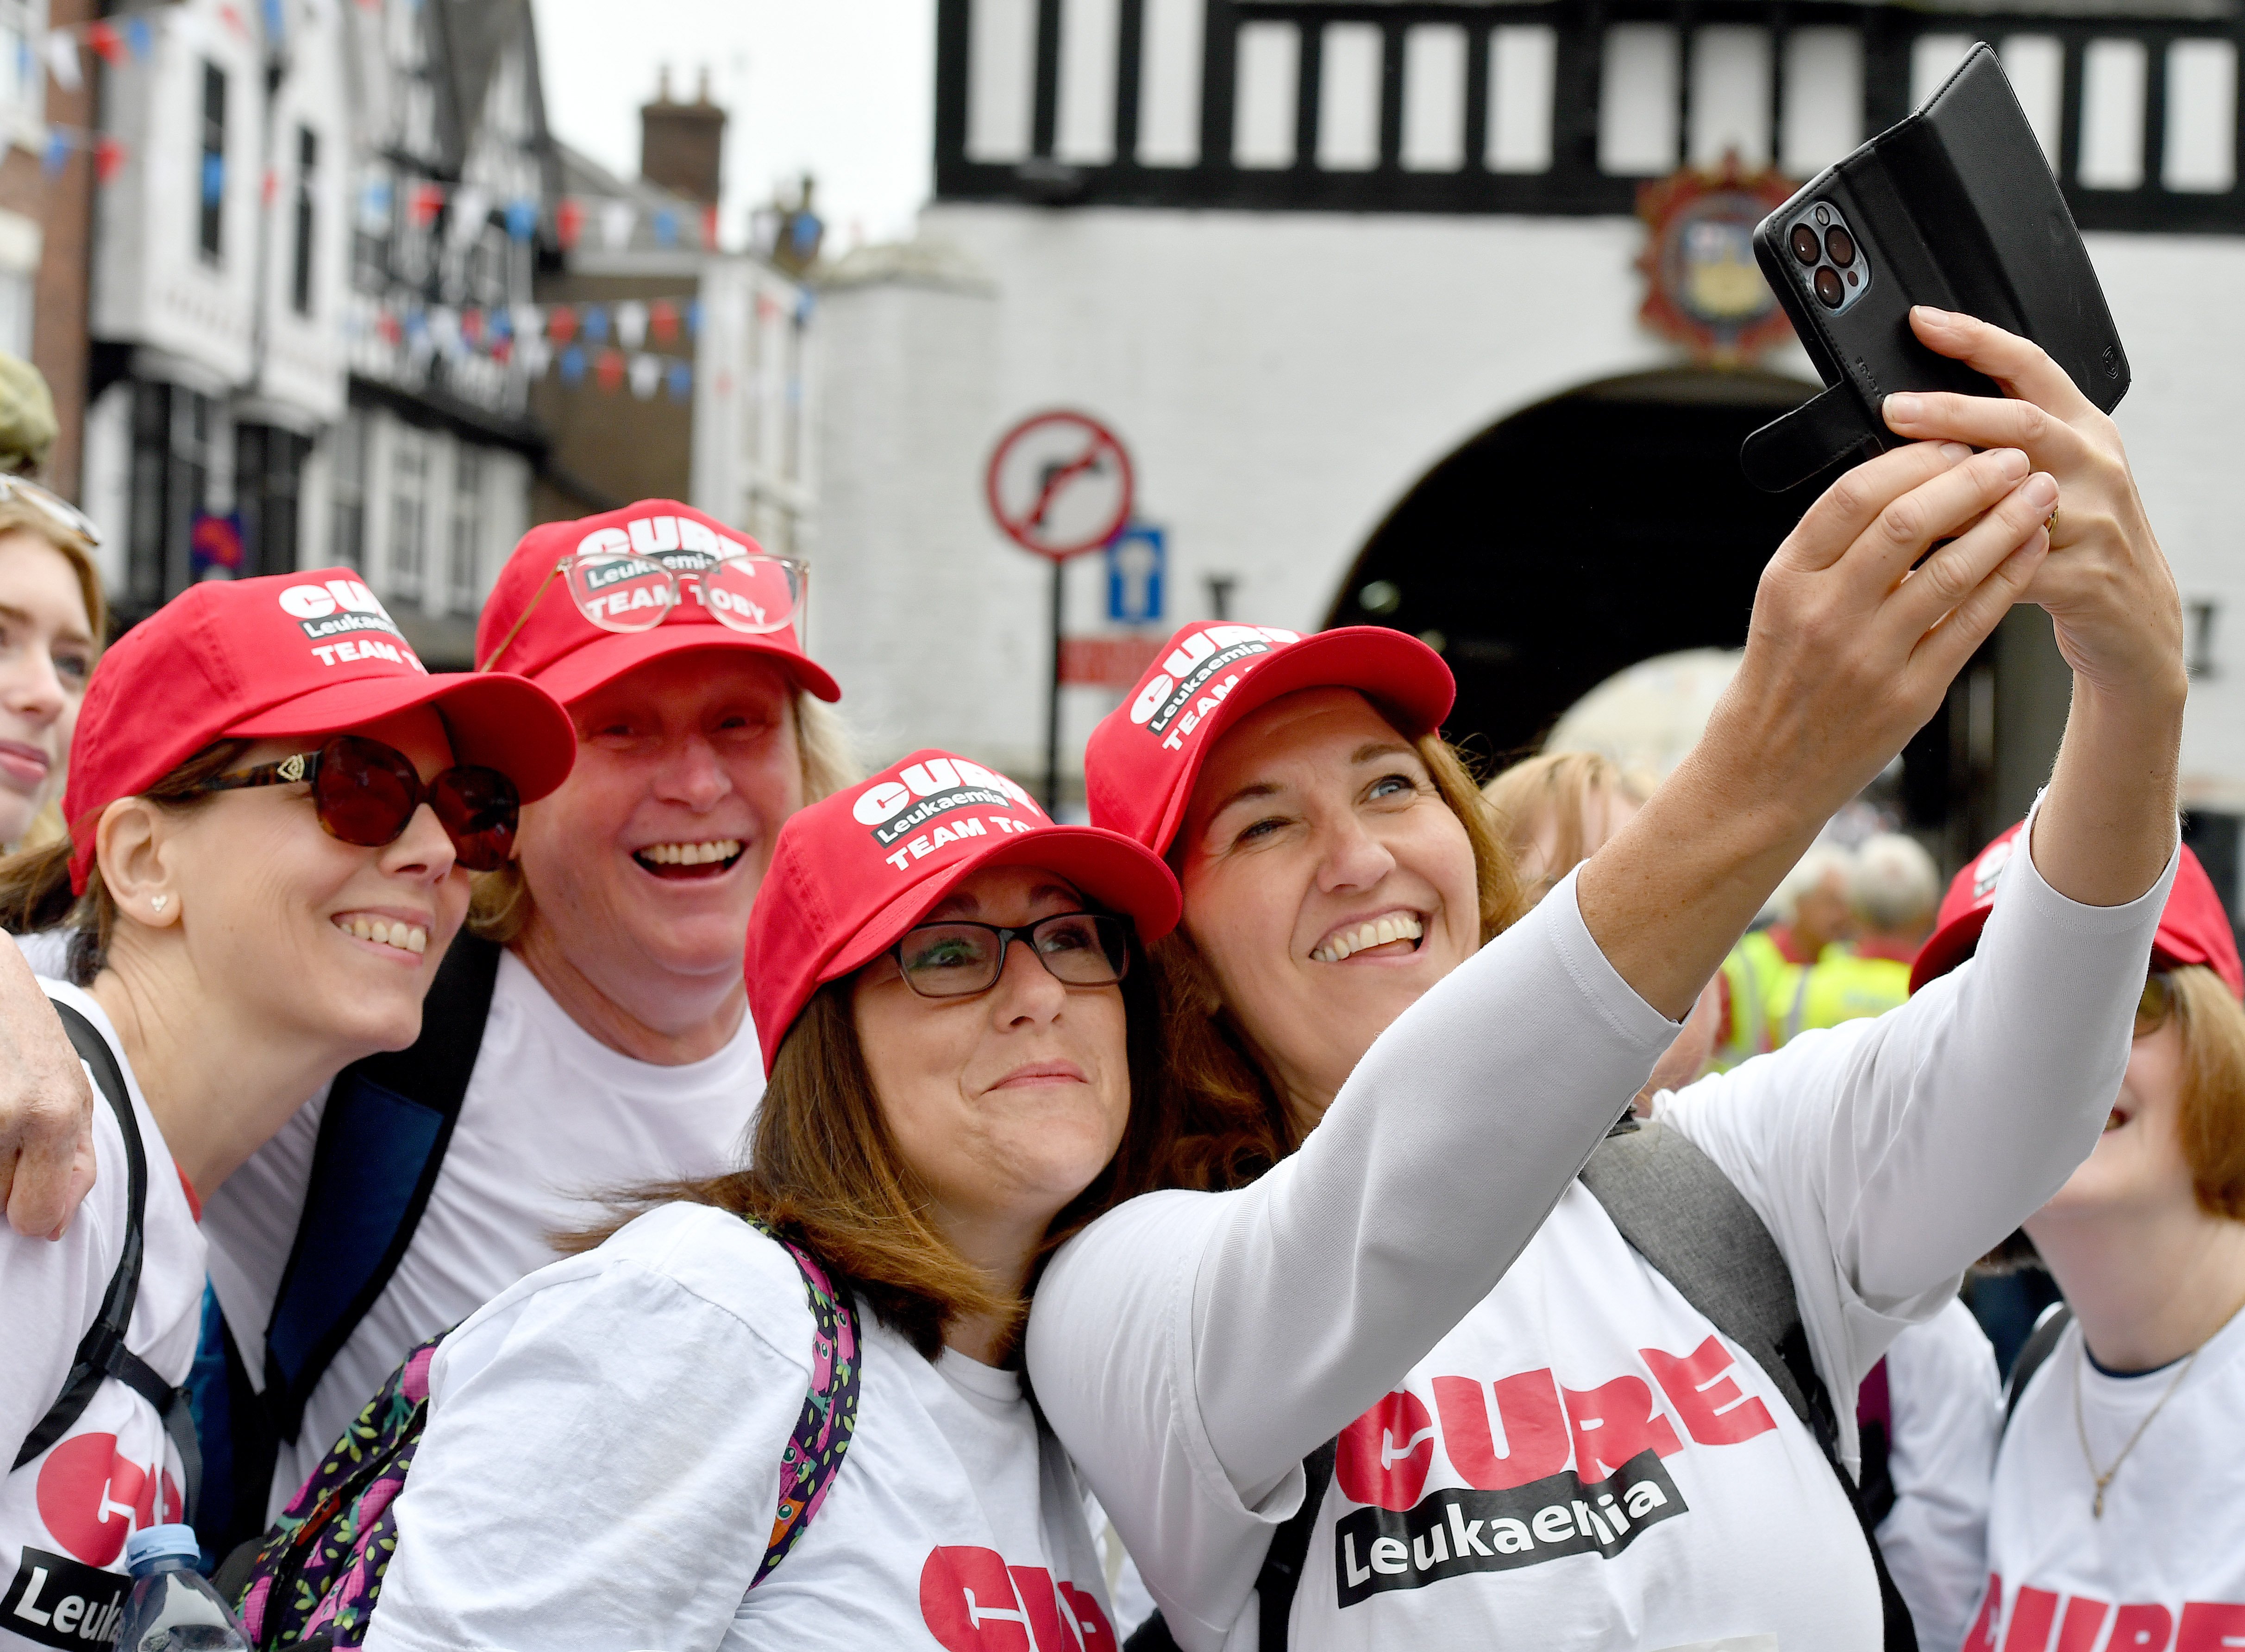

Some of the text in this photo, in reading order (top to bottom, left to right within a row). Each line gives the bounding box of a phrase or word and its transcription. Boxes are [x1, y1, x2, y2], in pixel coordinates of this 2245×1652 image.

[576, 515, 756, 578] CURE
[278, 579, 395, 619] CU
[586, 584, 681, 620] TEAM
[311, 639, 403, 666] TEAM
[1151, 643, 1268, 731] Leukaemia
[1161, 674, 1240, 751] TEAM
[853, 758, 1041, 826] CURE
[877, 789, 1010, 844] Leukaemia
[885, 816, 1036, 871] TEAM TO
[1335, 1334, 1778, 1512] CURE
